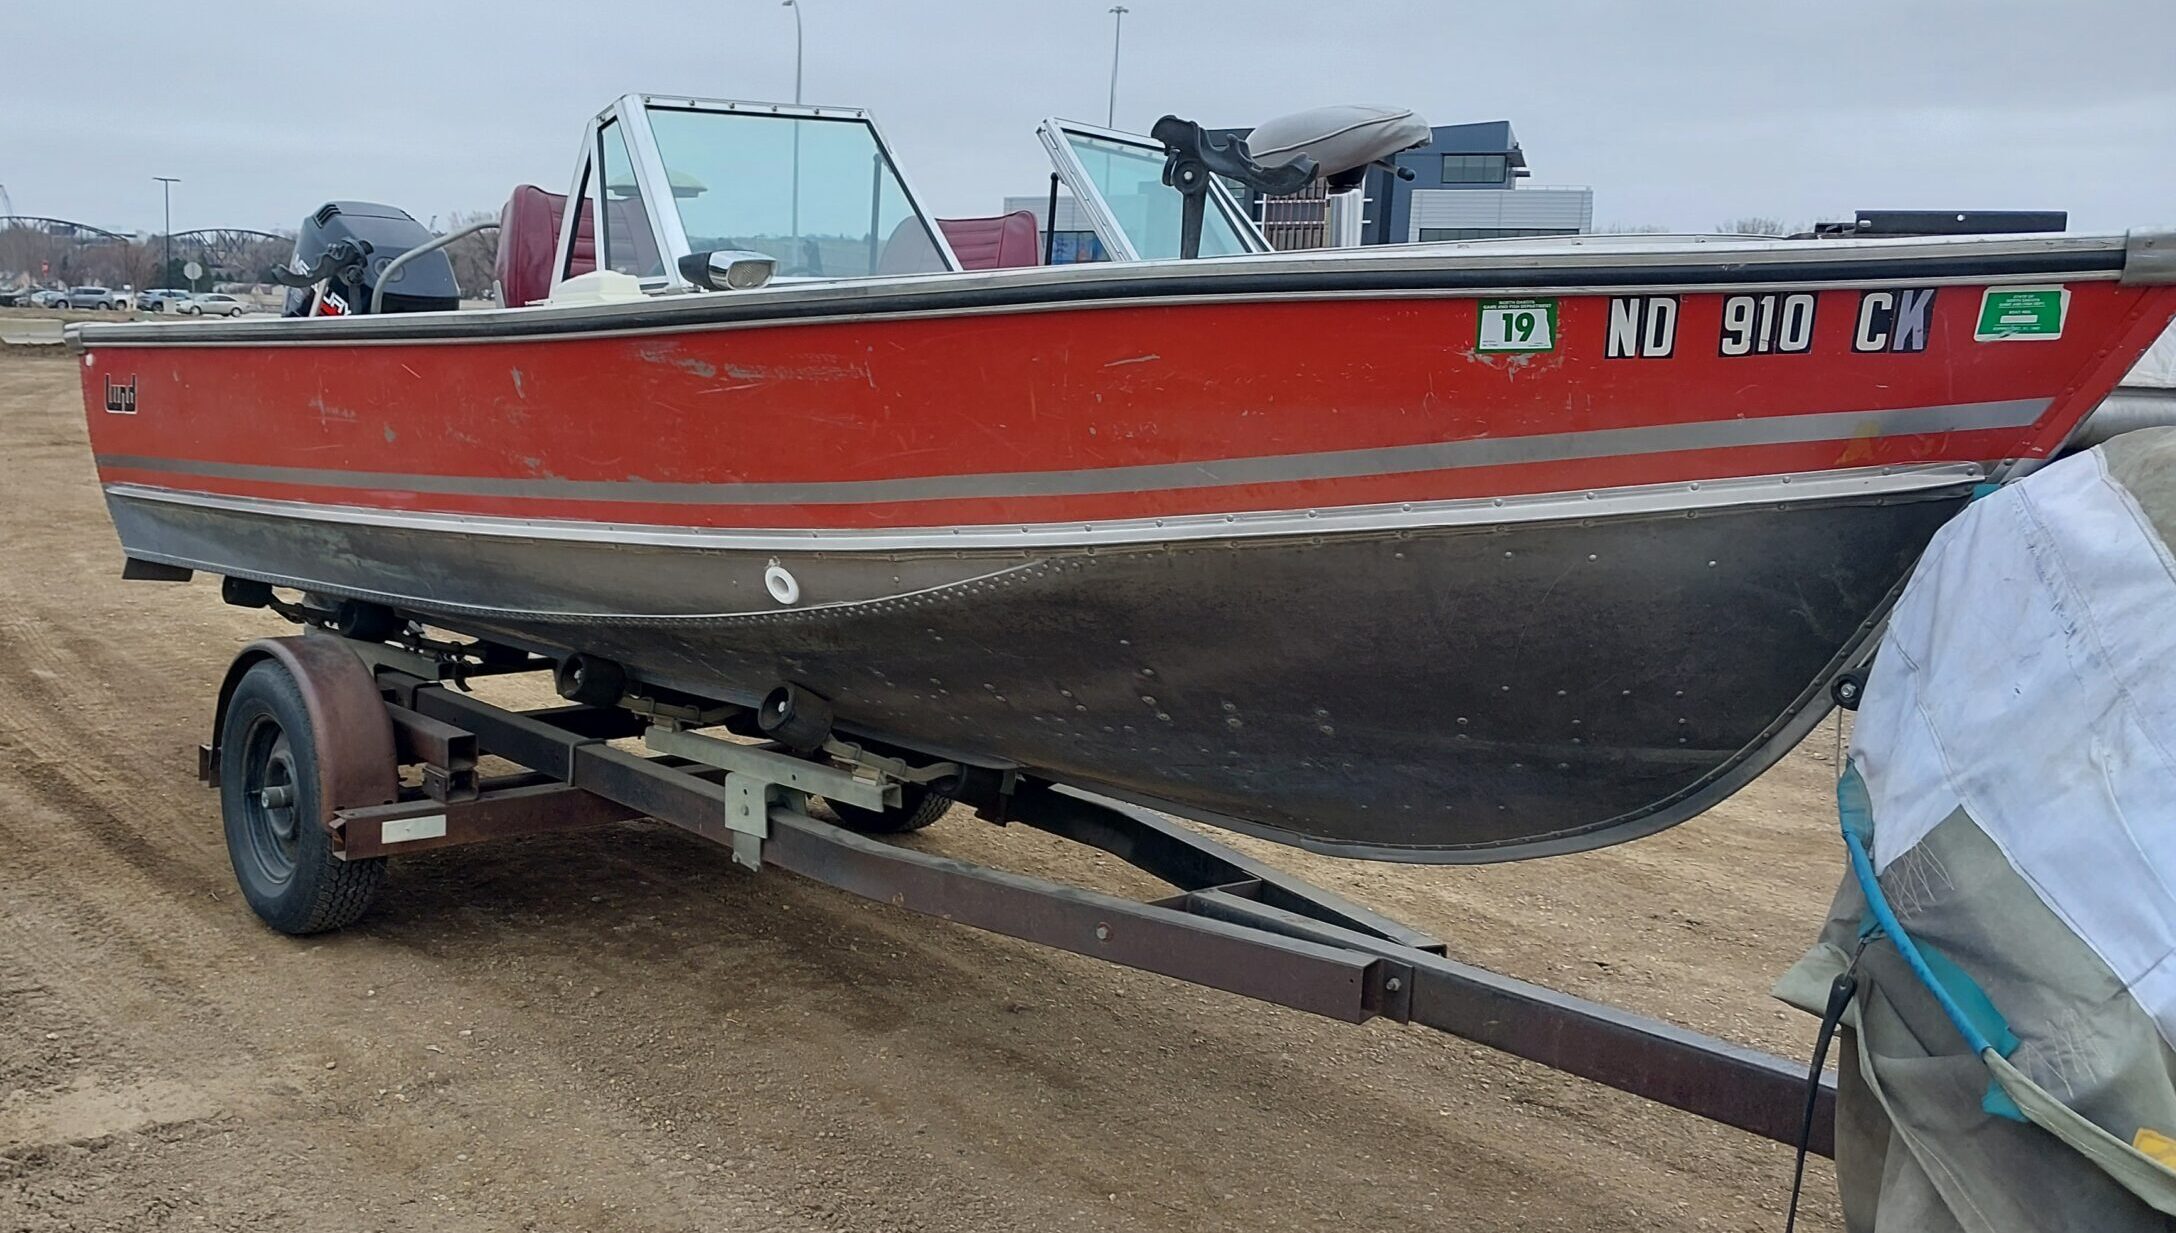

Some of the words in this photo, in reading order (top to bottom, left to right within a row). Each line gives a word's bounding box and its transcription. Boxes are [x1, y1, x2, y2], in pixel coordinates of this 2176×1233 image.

[1502, 312, 1536, 342] 19
[1608, 297, 1677, 357] ND
[1721, 294, 1814, 356] 910
[1855, 289, 1935, 351] CK
